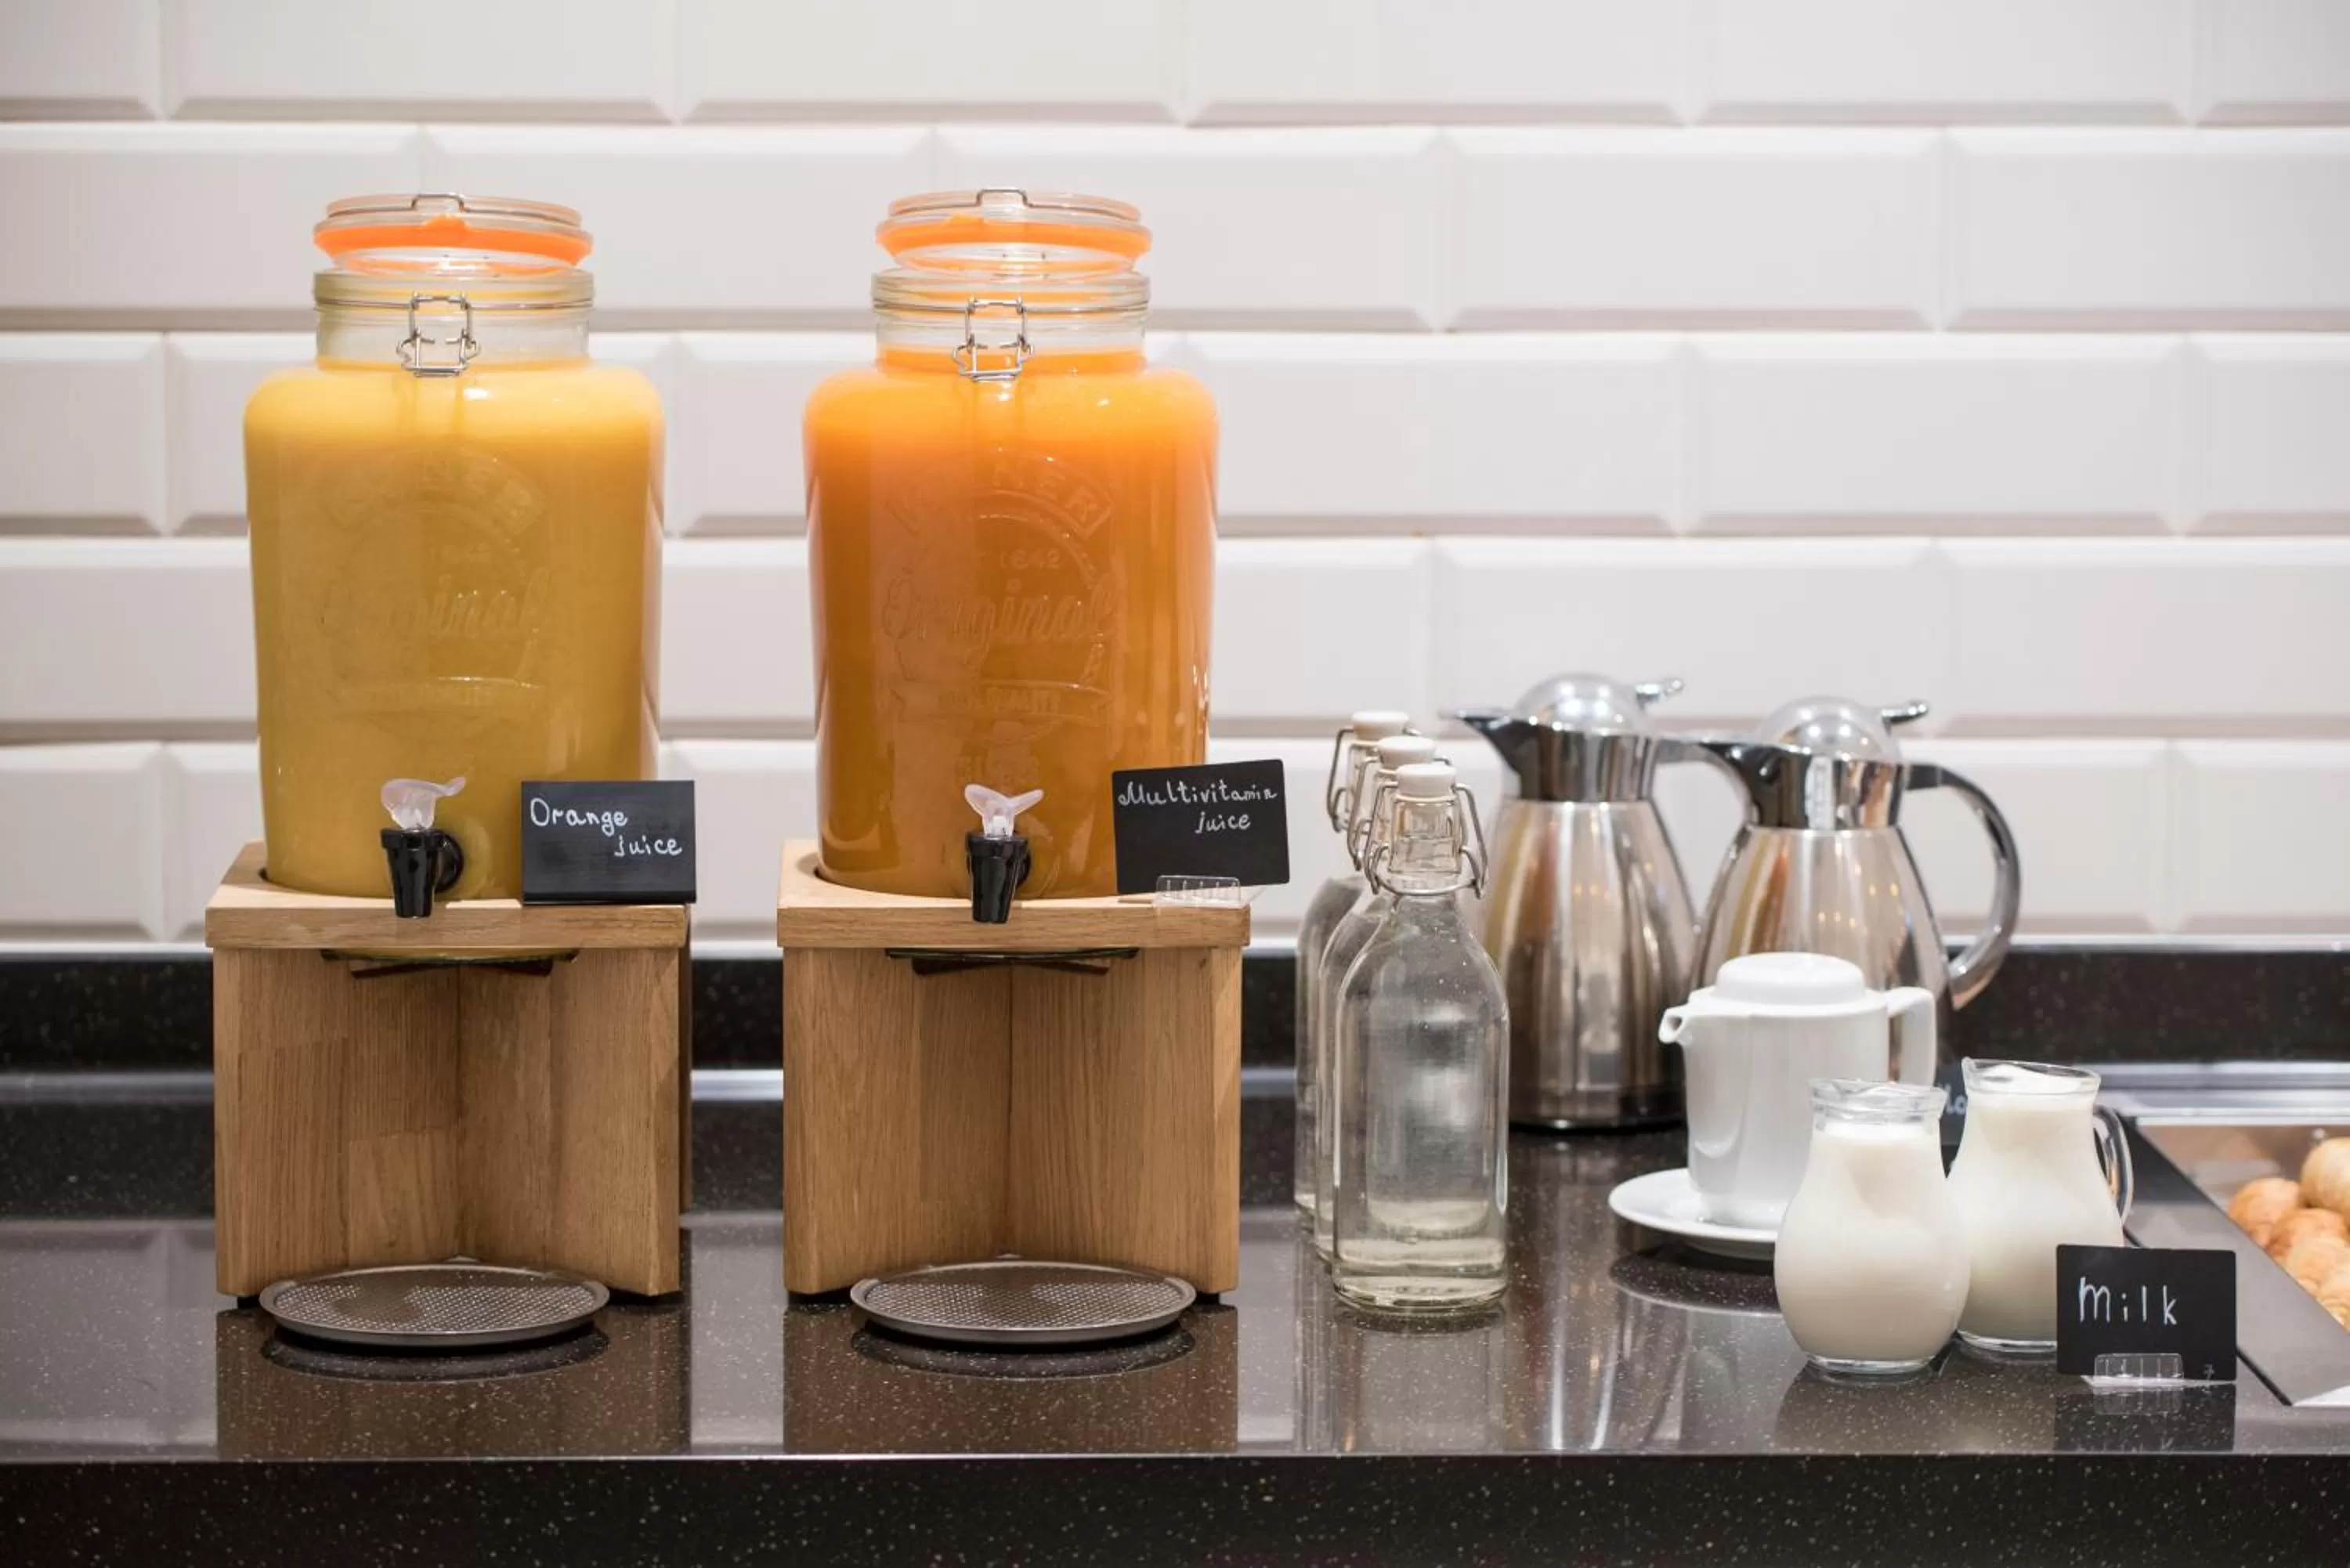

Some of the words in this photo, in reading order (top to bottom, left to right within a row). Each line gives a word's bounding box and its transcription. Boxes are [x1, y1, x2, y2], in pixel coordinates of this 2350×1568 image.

[1118, 779, 1278, 806] Multivitamin
[530, 797, 628, 836] Orange
[1195, 811, 1251, 834] juice
[613, 835, 682, 858] juice
